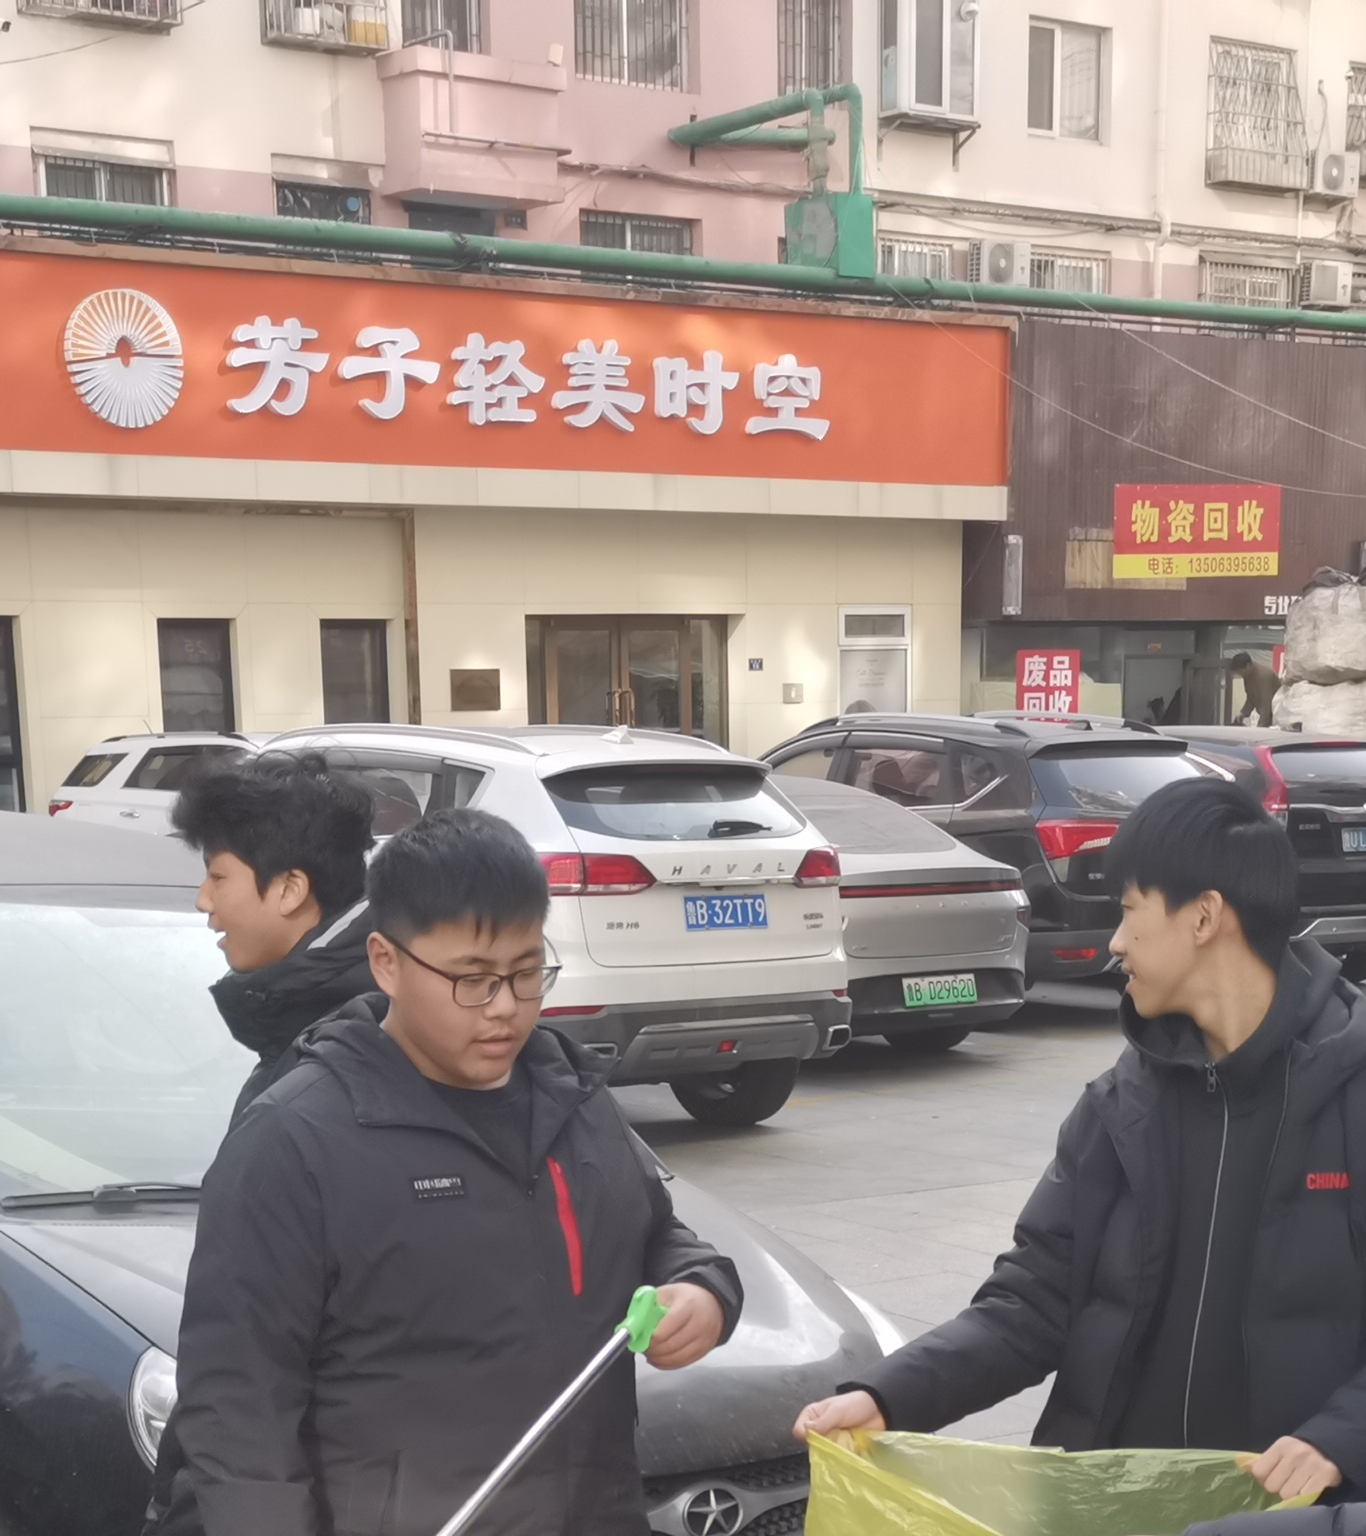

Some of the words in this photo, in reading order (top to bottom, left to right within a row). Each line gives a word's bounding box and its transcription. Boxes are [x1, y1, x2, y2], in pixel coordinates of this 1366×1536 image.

[225, 316, 830, 441] 芳子轻美时空
[1131, 499, 1264, 544] 物资回收
[1188, 556, 1270, 574] 13506395638
[1022, 654, 1072, 688] 废品
[1023, 690, 1073, 716] 回收
[671, 862, 785, 877] HAVAL
[686, 898, 766, 927] 鲁B·32TT9
[1306, 1172, 1350, 1190] CHINA
